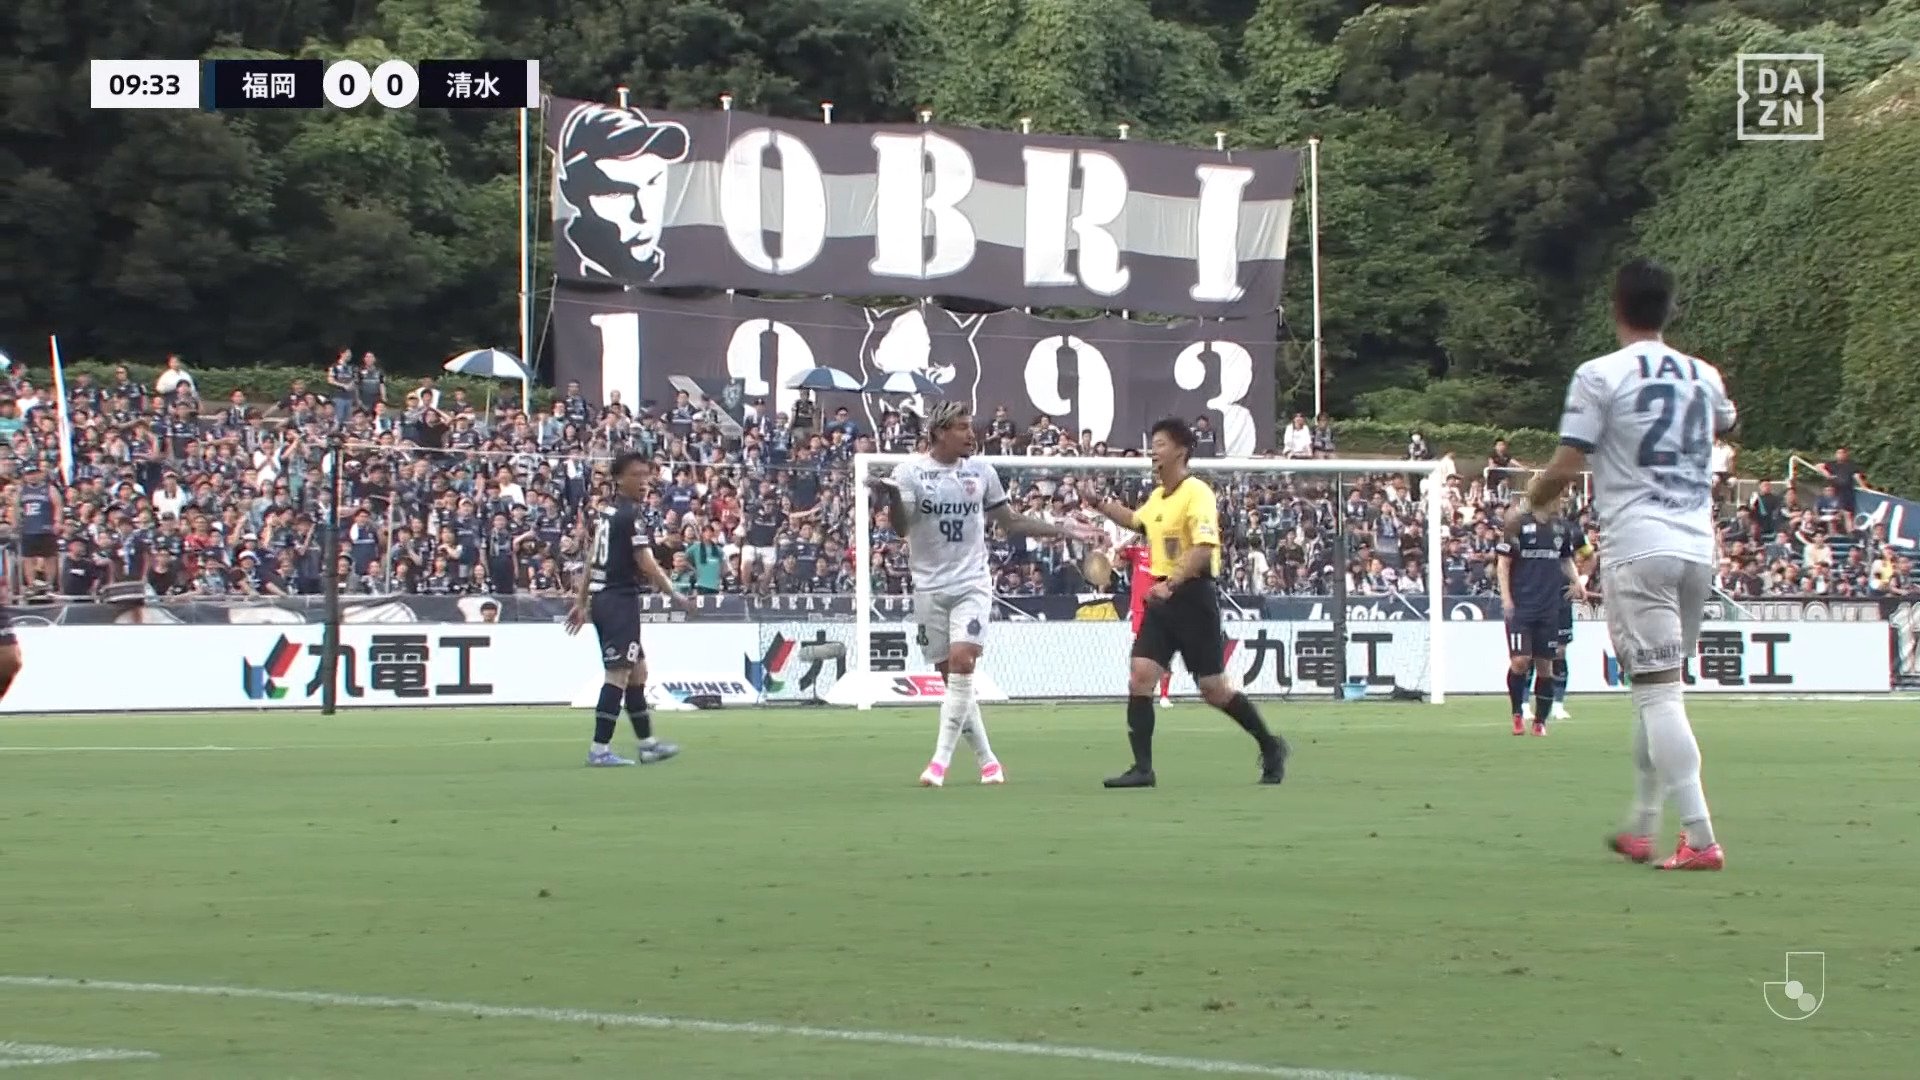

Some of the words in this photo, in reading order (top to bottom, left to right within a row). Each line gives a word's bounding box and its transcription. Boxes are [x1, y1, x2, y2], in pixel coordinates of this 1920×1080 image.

[720, 127, 1255, 302] OBRI
[1636, 354, 1699, 380] IAI
[1634, 383, 1712, 468] 24
[921, 499, 980, 516] Suzuyo
[939, 520, 964, 542] 98
[1243, 628, 1396, 688] 九電工
[1510, 633, 1522, 650] 11
[1682, 630, 1794, 686] 電工
[306, 634, 493, 698] 九電工
[661, 681, 748, 695] WINNER
